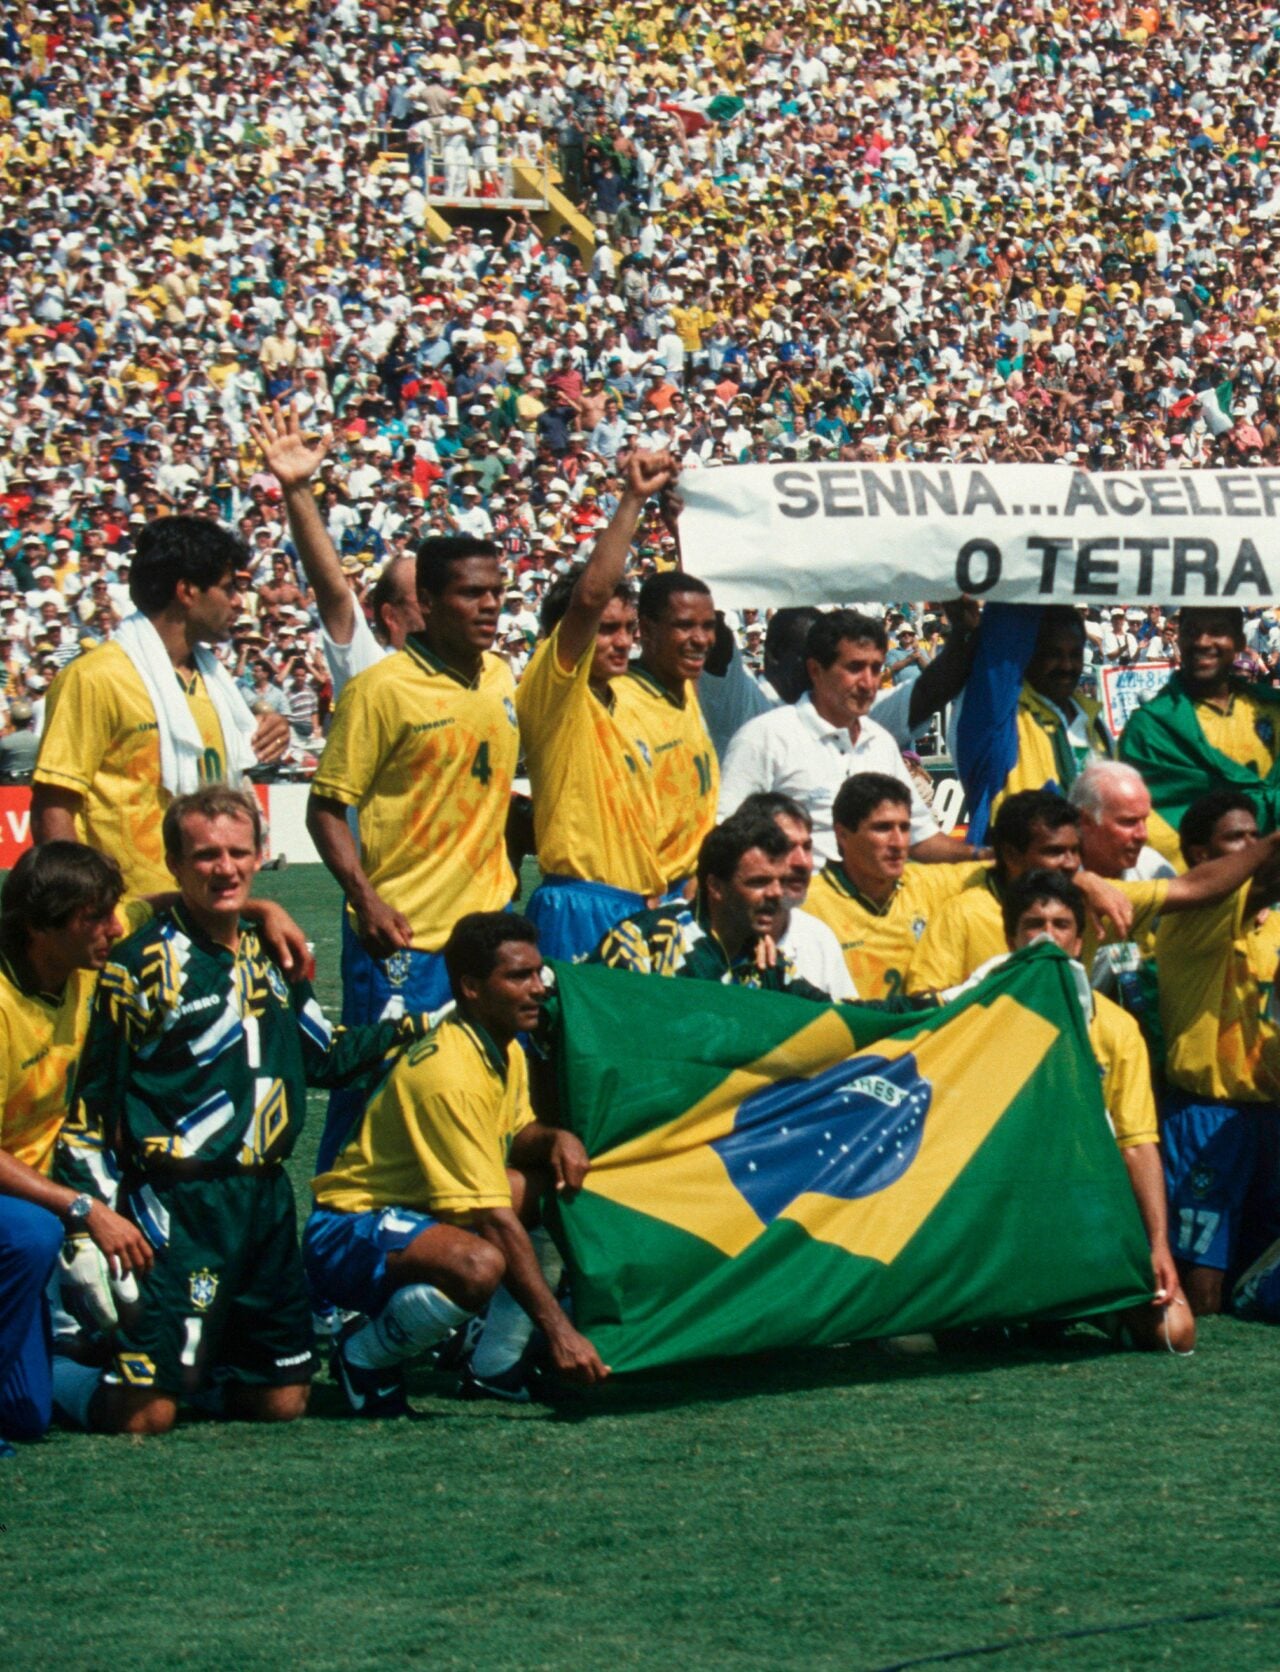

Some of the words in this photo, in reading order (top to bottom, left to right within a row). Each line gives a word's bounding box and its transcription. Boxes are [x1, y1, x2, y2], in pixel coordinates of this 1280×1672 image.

[955, 538, 1003, 595] O
[1026, 536, 1272, 597] TETRA
[471, 741, 493, 786] 4
[170, 993, 221, 1020] UMBRO
[242, 1016, 261, 1069] 1
[1177, 1207, 1221, 1255] 17
[181, 1316, 203, 1367] 1
